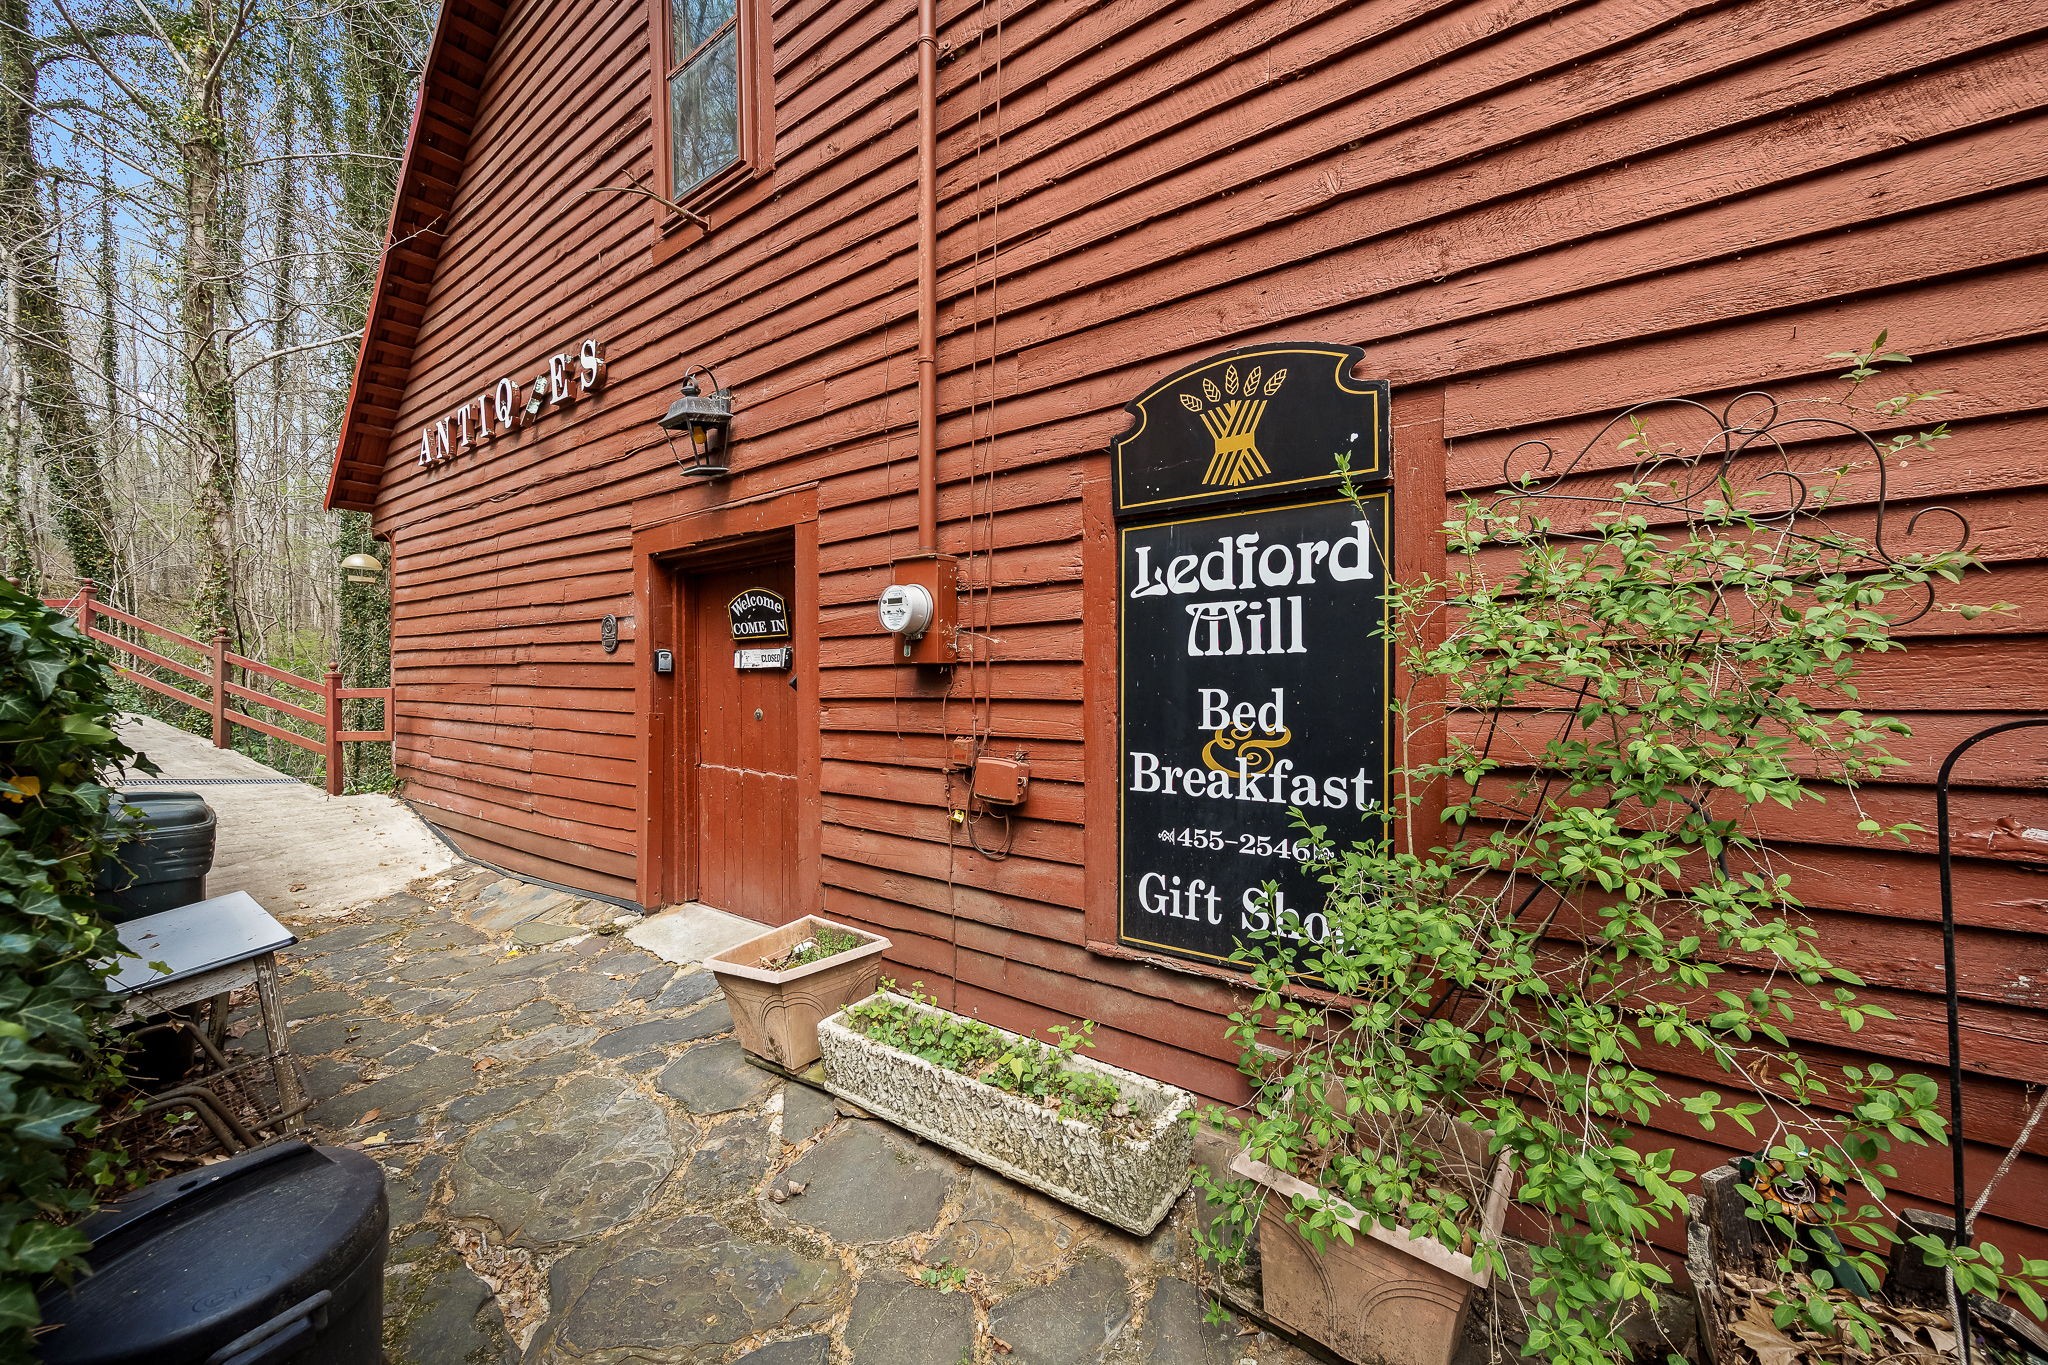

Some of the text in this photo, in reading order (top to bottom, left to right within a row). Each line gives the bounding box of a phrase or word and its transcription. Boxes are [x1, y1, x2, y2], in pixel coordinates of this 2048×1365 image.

[418, 338, 606, 467] ANTIQES
[1130, 519, 1373, 599] Ledford
[731, 593, 782, 617] Welcome
[733, 619, 786, 635] COME IN
[1185, 595, 1308, 656] Mill
[761, 653, 781, 663] CLOSED
[1197, 687, 1287, 733] Bed
[1202, 721, 1292, 779] &
[1129, 751, 1375, 812] Breakfast
[1177, 827, 1310, 862] 455-2546
[1138, 871, 1356, 955] Gift Sho
